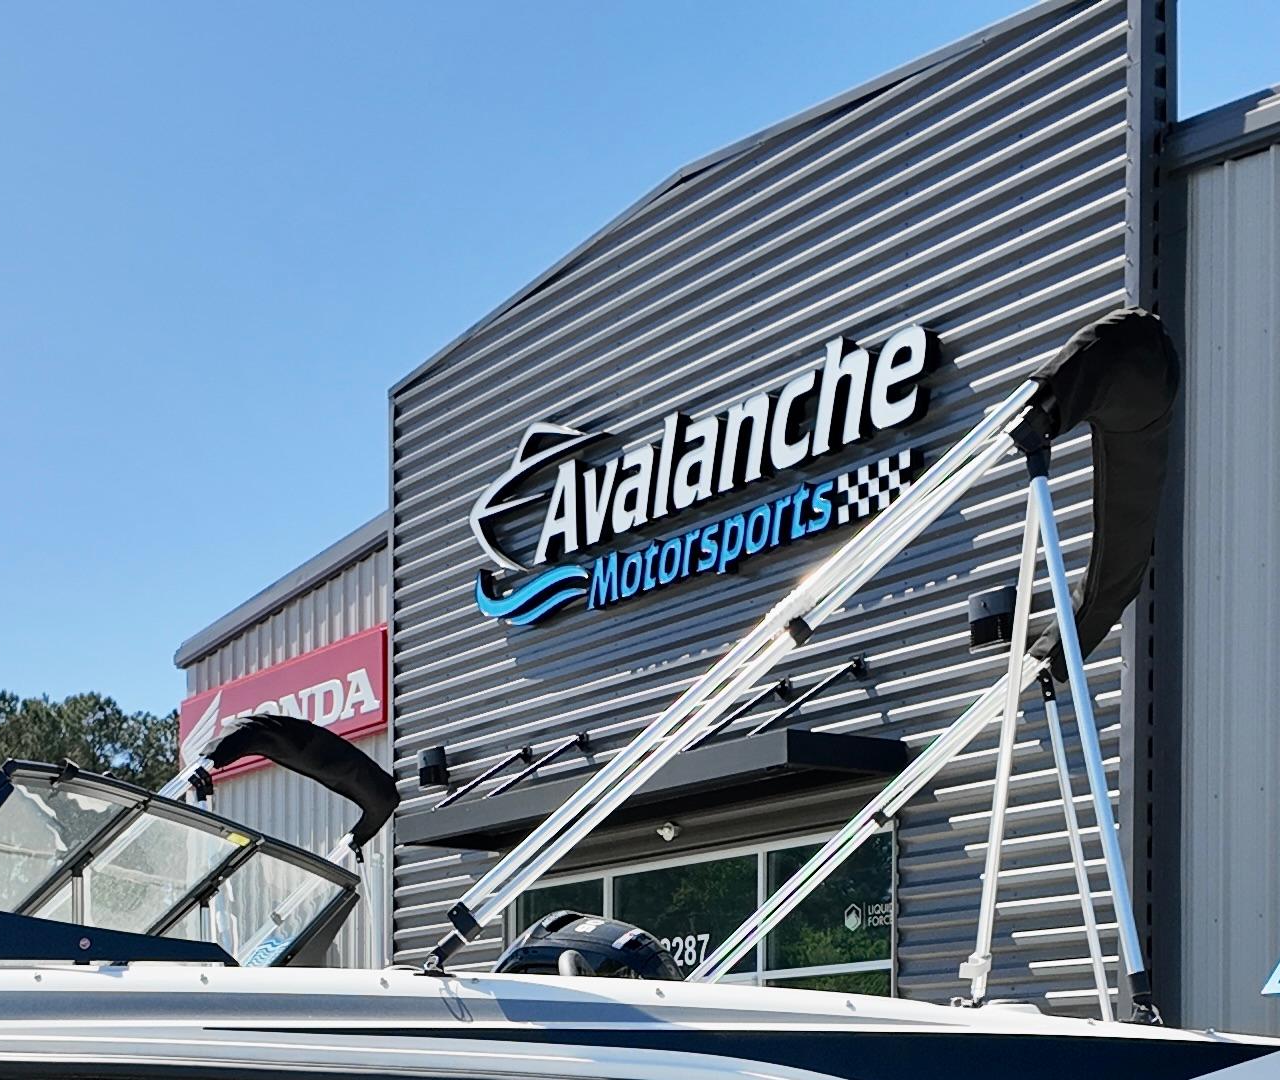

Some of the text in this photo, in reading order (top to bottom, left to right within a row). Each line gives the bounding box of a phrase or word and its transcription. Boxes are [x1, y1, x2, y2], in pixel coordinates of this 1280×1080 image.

[534, 325, 926, 564] Avalanche
[587, 479, 834, 610] Motorsports
[221, 668, 380, 727] NDA
